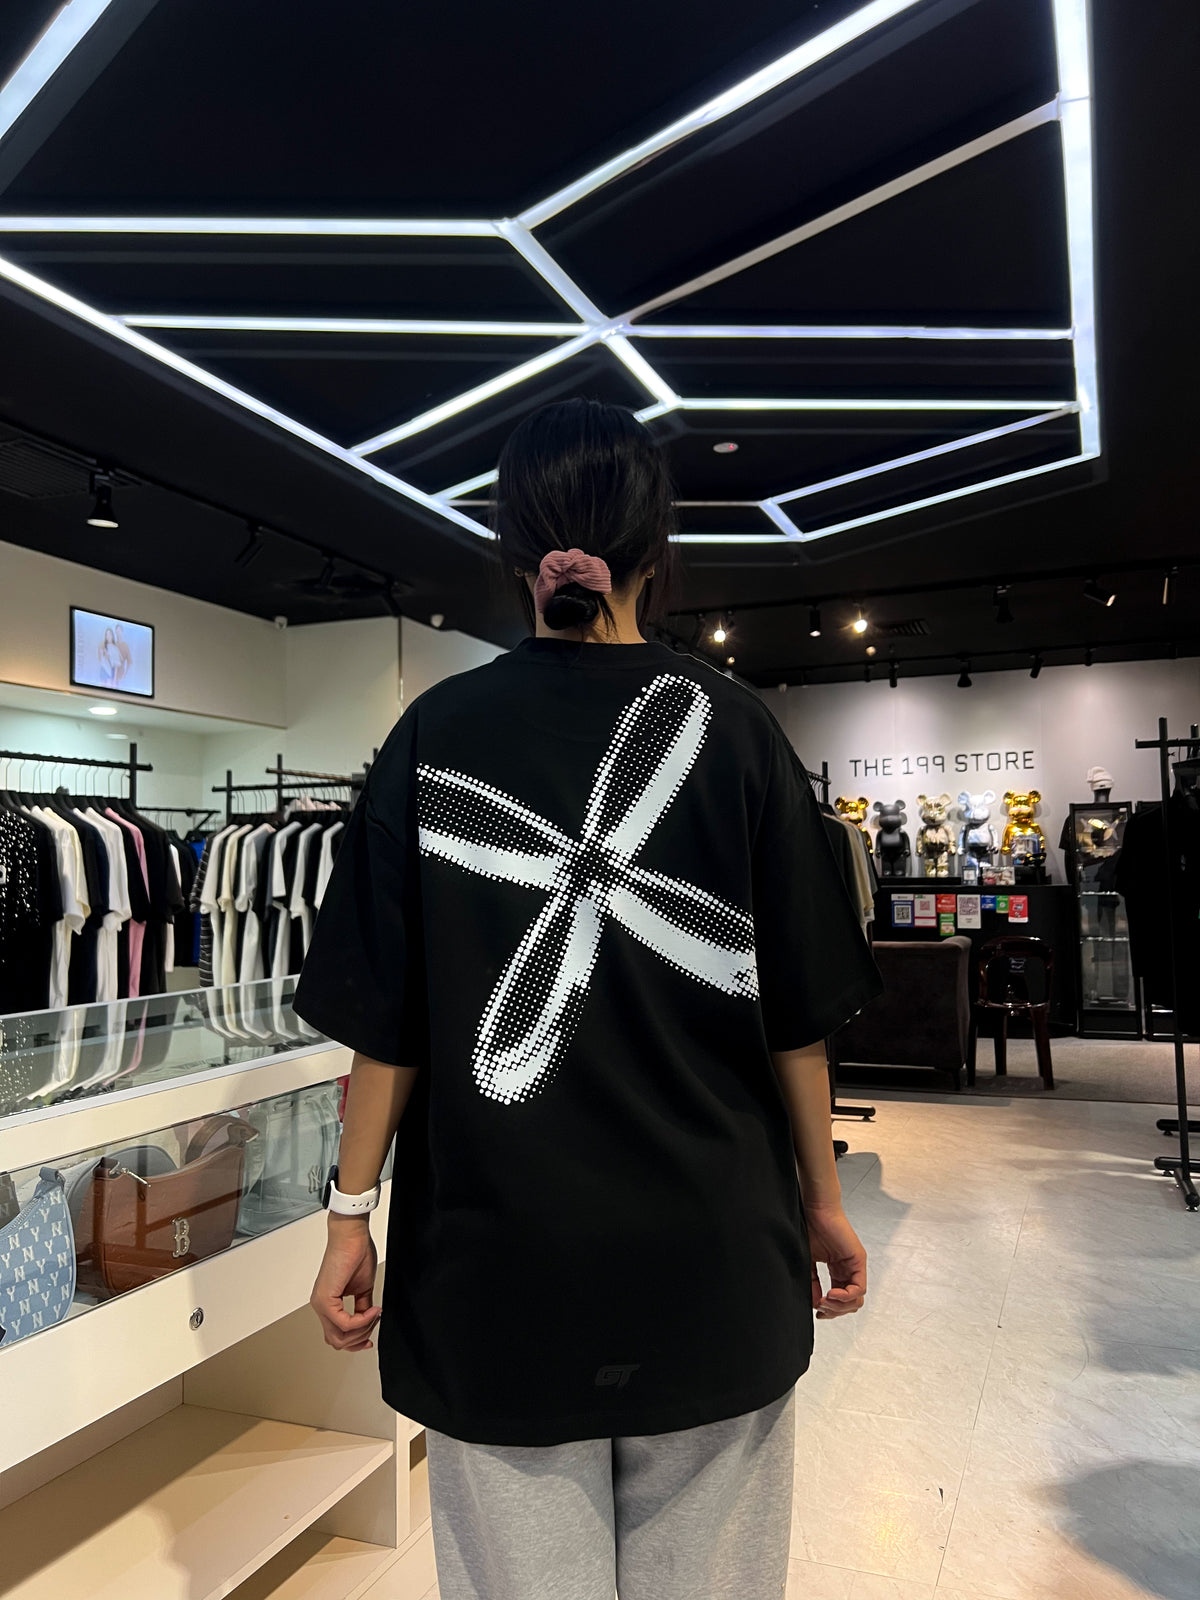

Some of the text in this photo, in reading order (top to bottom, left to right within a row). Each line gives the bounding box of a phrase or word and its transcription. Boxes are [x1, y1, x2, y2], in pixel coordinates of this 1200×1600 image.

[849, 750, 1035, 777] THE 199 STORE
[49, 1190, 62, 1206] N
[39, 1208, 50, 1223] Y
[8, 1221, 63, 1251] N Y N
[172, 1217, 190, 1258] B
[1, 1239, 53, 1269] Y N Y
[14, 1251, 68, 1283] N Y N
[6, 1271, 59, 1303] Y N Y
[19, 1298, 31, 1316] N
[41, 1291, 50, 1307] Y
[61, 1283, 70, 1301] N
[11, 1303, 61, 1336] Y N Y
